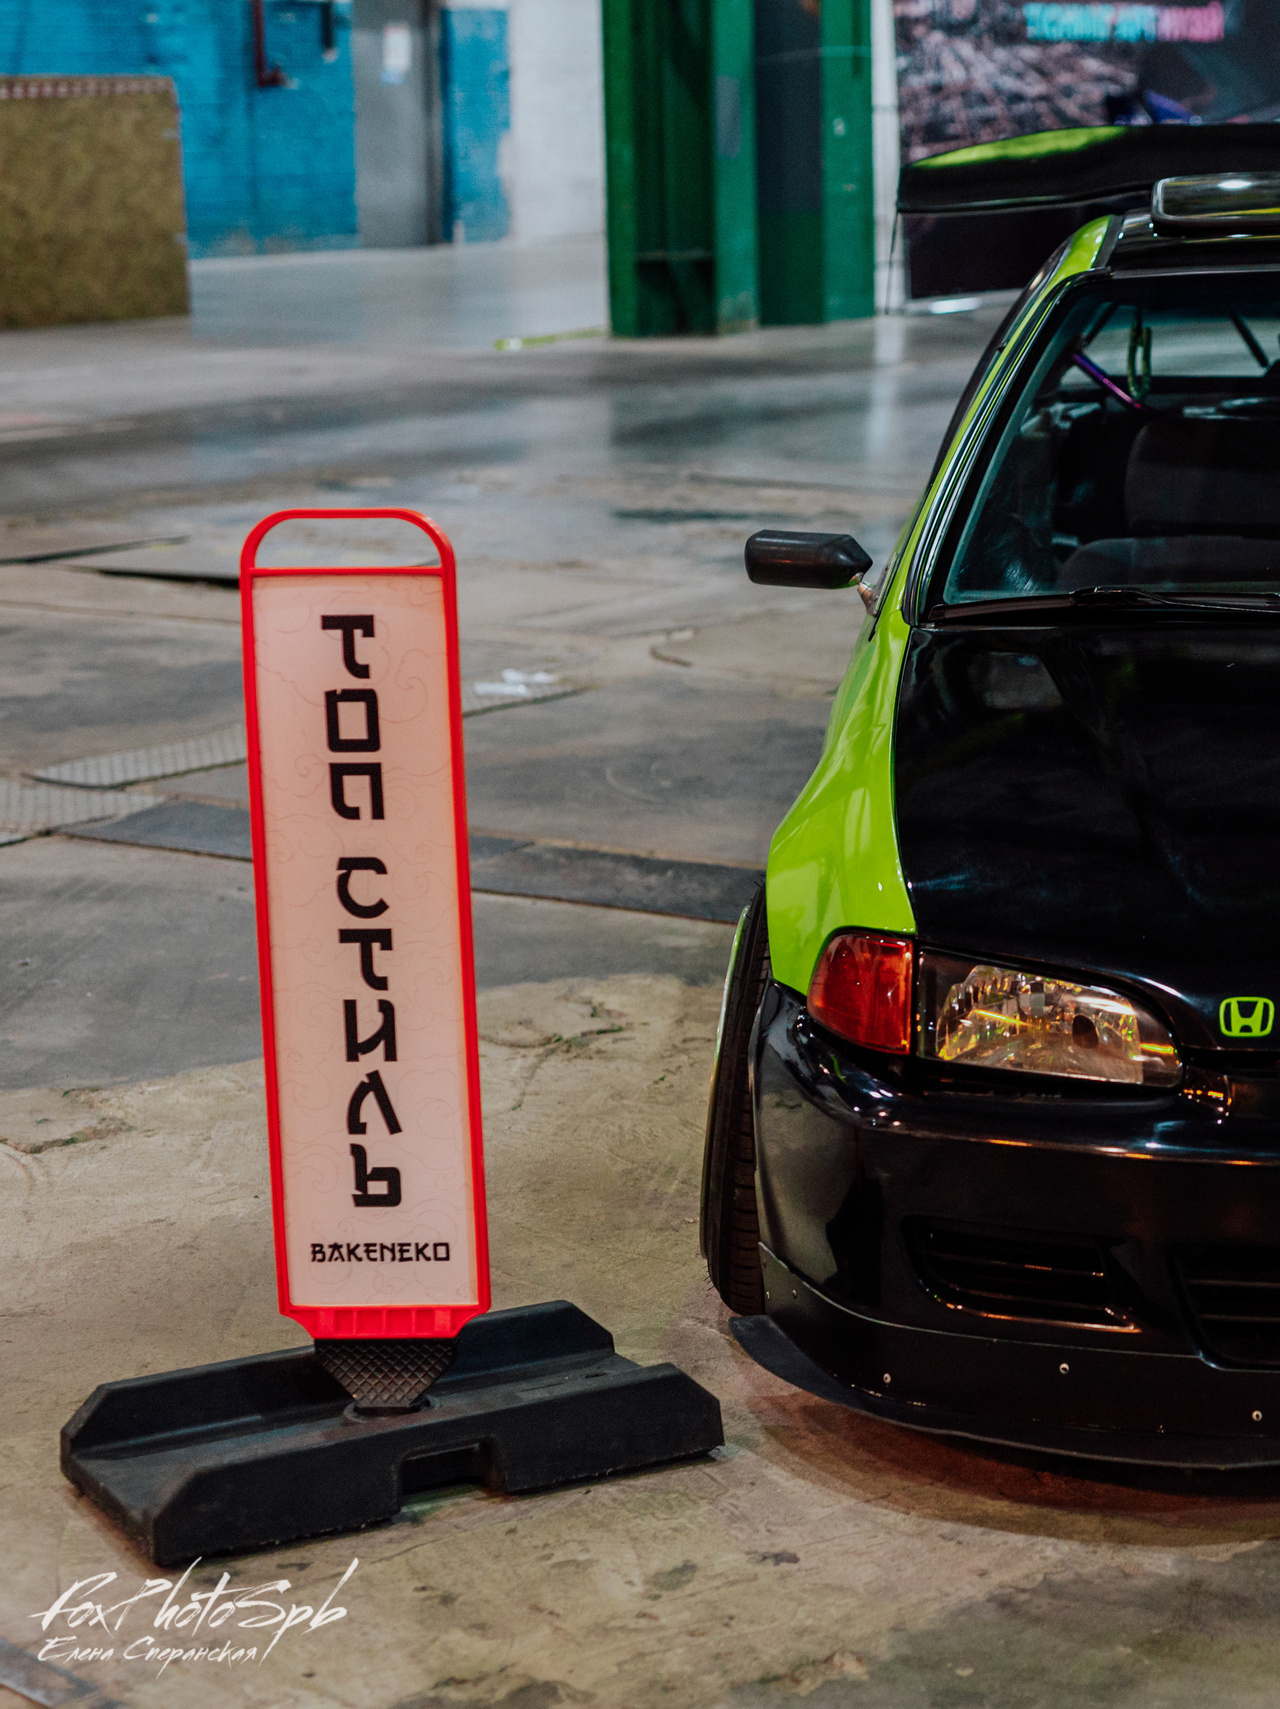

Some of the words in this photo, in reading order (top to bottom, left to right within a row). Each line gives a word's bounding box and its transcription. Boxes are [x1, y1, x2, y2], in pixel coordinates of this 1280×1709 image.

[321, 614, 386, 821] ТОП
[337, 856, 403, 1208] СТИЛЬ
[310, 1242, 451, 1263] BAKENEKO
